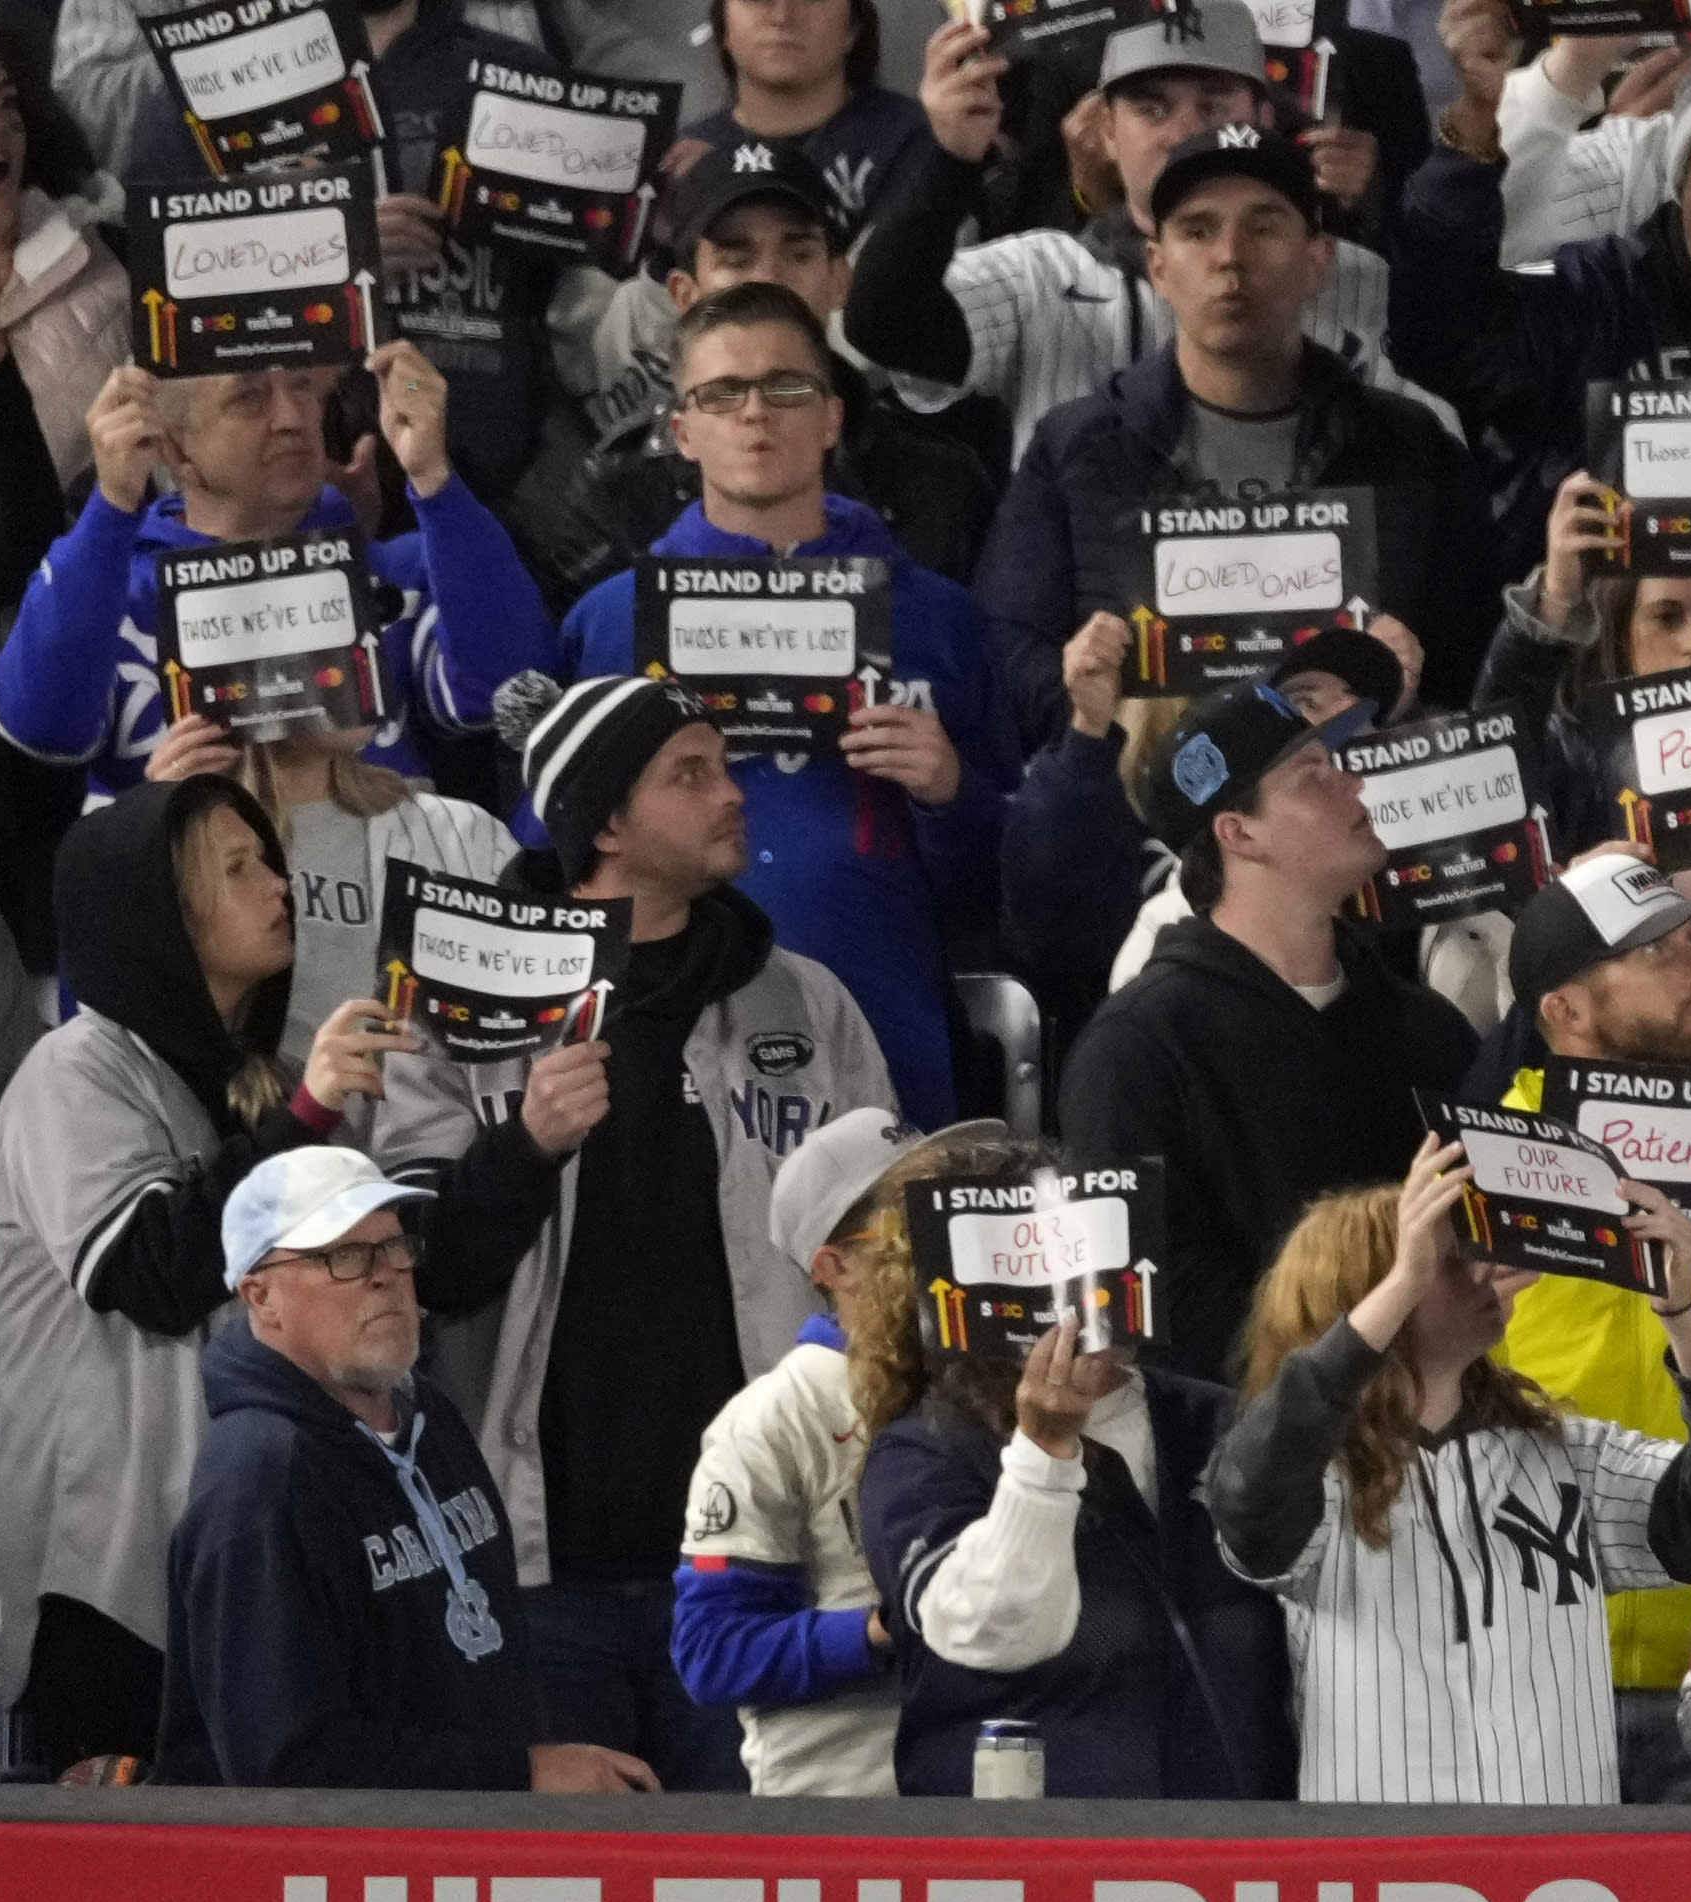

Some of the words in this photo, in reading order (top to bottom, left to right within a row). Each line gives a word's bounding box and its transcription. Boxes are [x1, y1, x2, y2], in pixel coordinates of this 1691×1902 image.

[1140, 510, 1151, 533] I
[1157, 507, 1246, 533] STAND
[1252, 504, 1289, 528] UP
[1294, 502, 1349, 526] FOR
[164, 564, 173, 586] I
[174, 554, 255, 585] STAND
[259, 547, 297, 573] UP
[302, 539, 351, 566] FOR
[1162, 559, 1260, 598] LOVED
[1261, 560, 1340, 598] ONES
[183, 615, 233, 640] THOSE
[307, 597, 348, 624] LOST
[408, 875, 416, 896] I
[422, 881, 503, 918] STAND
[510, 903, 546, 925] UP
[553, 907, 607, 929] FOR
[546, 956, 588, 976] LOST
[1569, 1069, 1579, 1091] I
[1586, 1071, 1675, 1100] STAND
